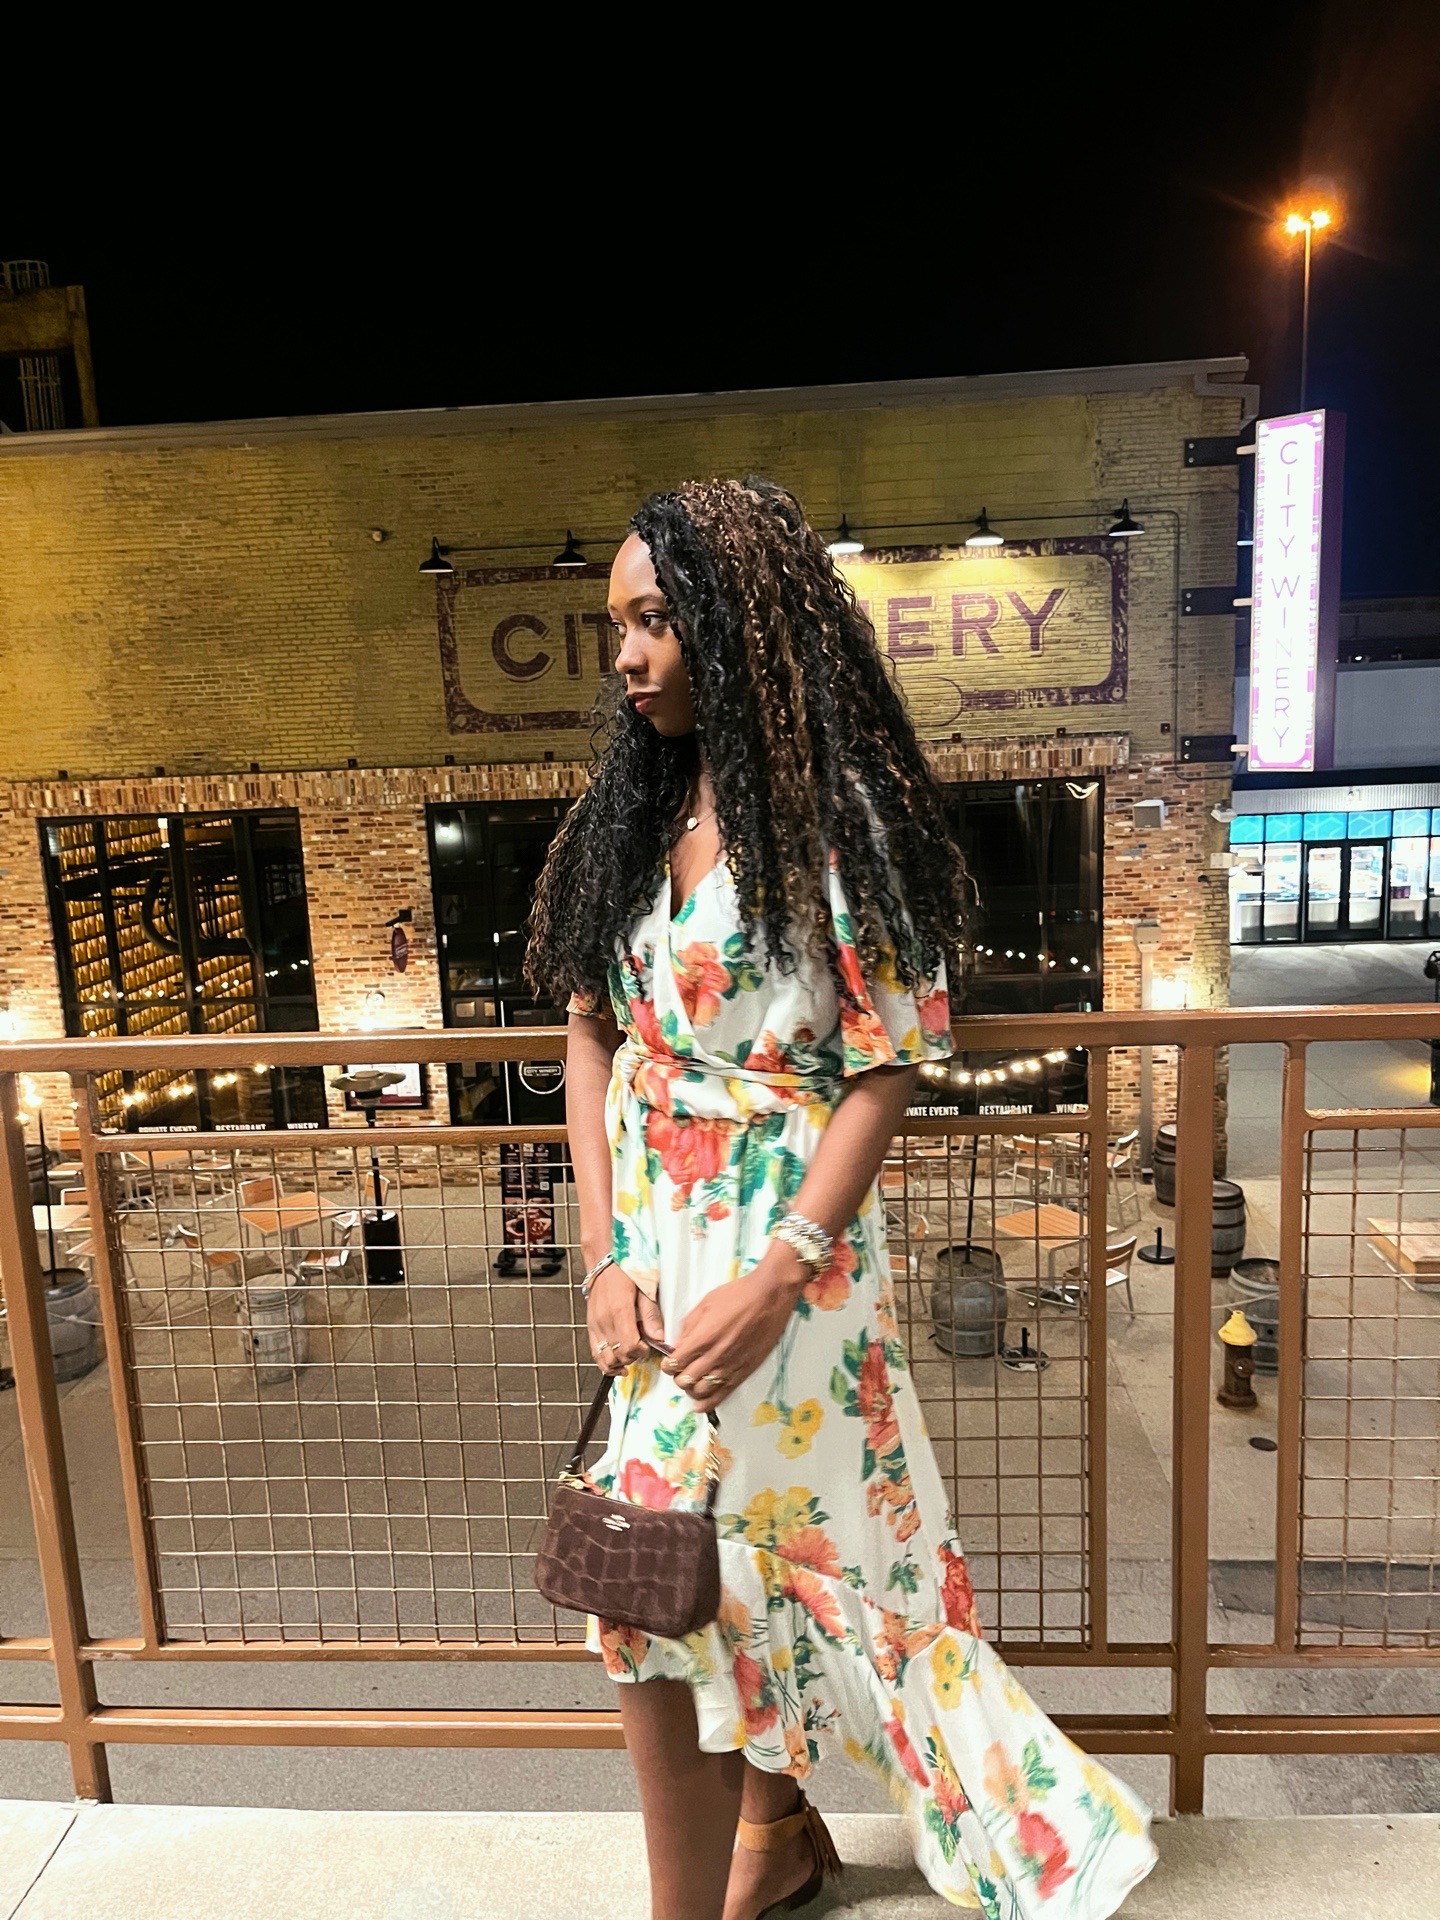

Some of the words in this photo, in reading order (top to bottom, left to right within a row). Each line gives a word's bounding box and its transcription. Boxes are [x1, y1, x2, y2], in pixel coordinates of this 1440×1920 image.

[1277, 440, 1299, 559] CITY
[857, 588, 1070, 661] ERY
[1271, 574, 1301, 749] WINERY
[903, 1106, 928, 1117] IVATE
[928, 1105, 959, 1116] EVENTS
[979, 1104, 1033, 1115] RESTAURANT
